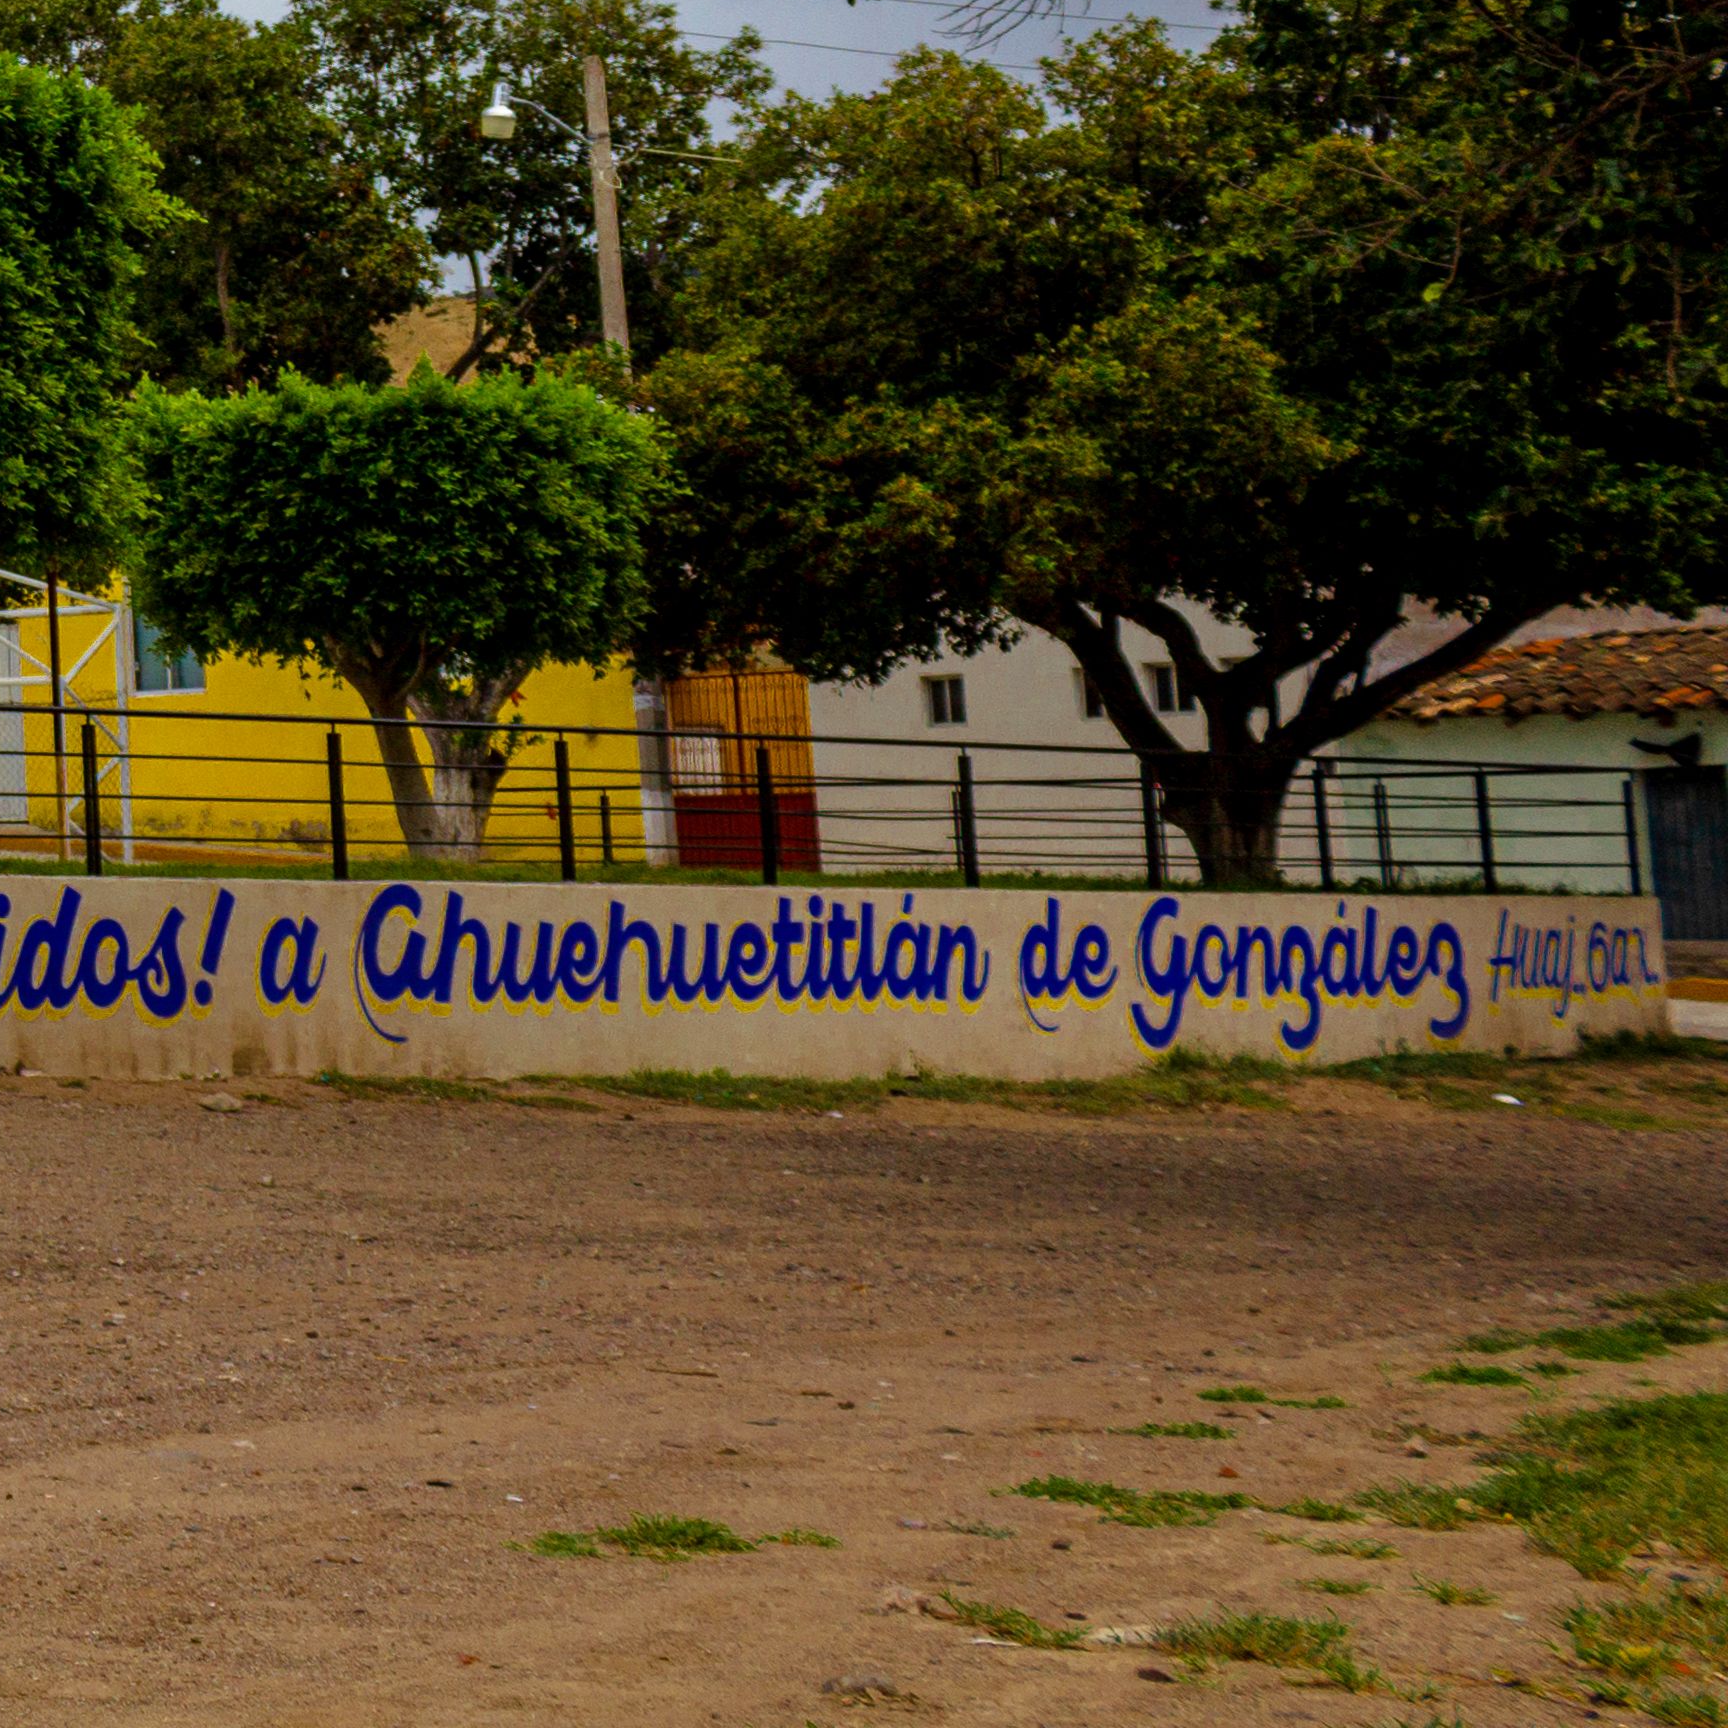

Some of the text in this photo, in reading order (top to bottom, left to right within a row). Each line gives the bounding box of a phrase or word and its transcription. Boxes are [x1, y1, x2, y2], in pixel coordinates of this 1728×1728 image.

[259, 915, 327, 1006] a
[355, 884, 990, 1043] Ahuehuetitlán
[1019, 897, 1118, 1033] de
[1130, 897, 1471, 1050] González
